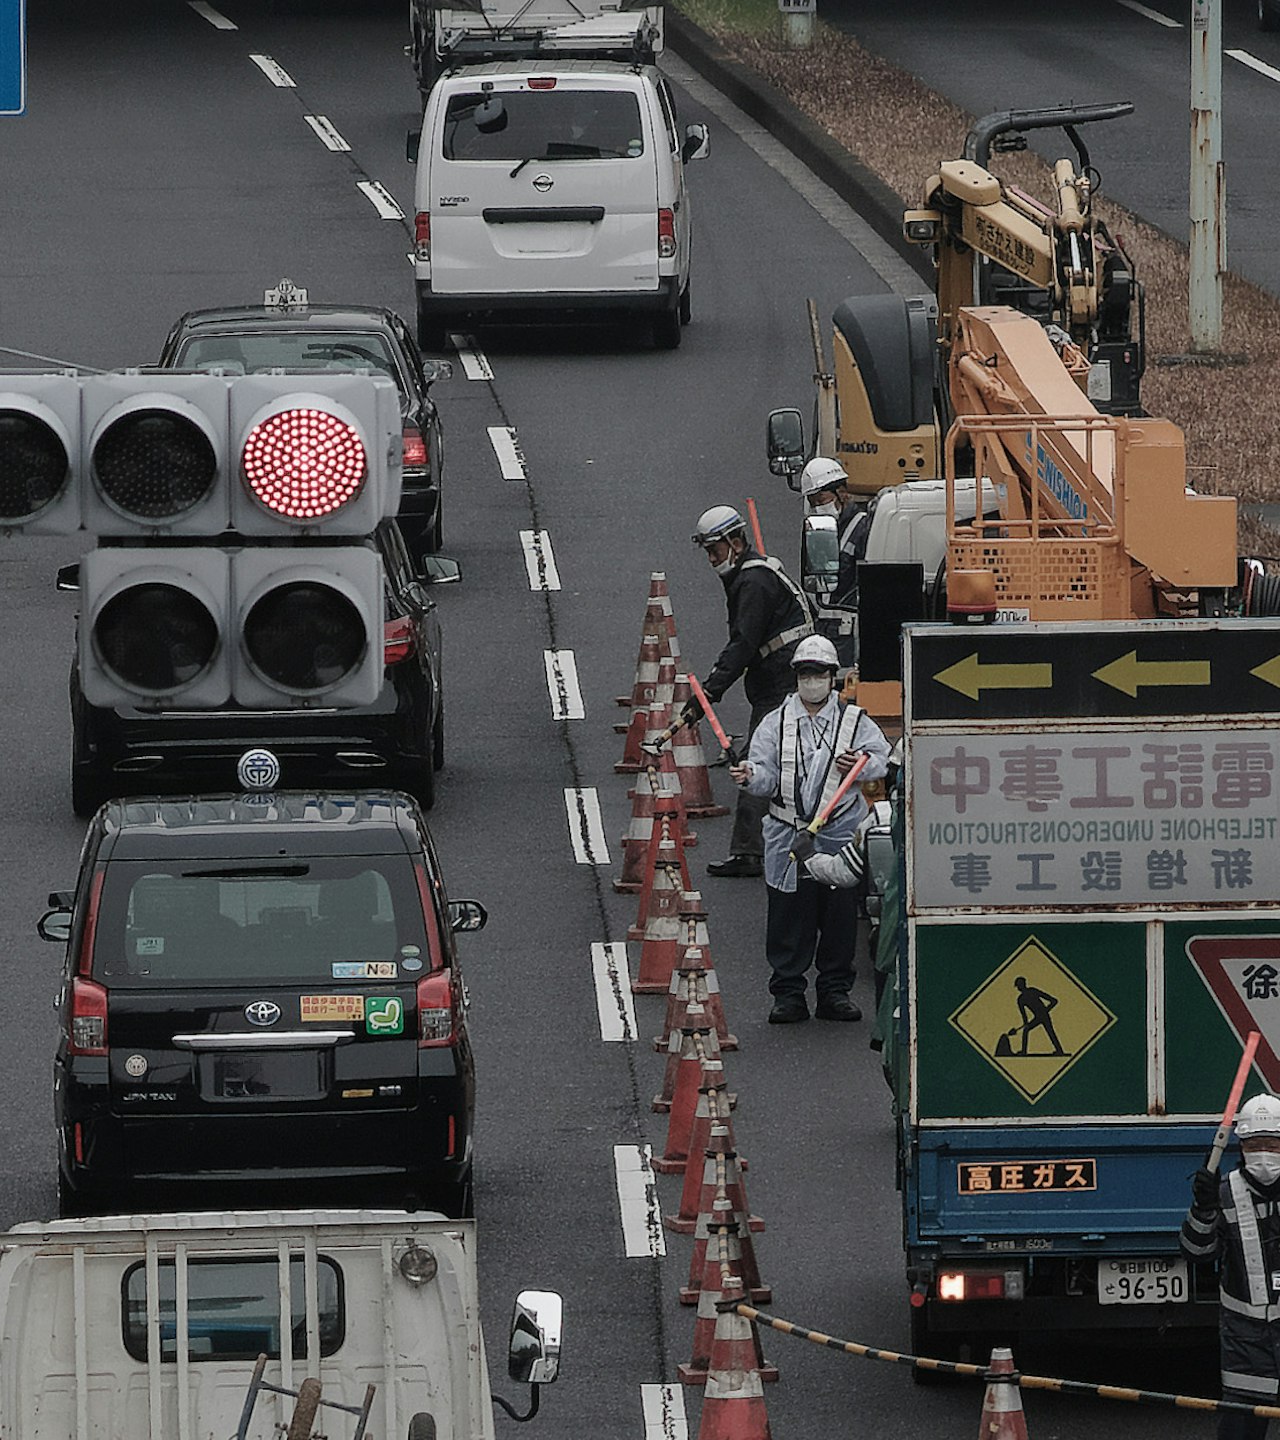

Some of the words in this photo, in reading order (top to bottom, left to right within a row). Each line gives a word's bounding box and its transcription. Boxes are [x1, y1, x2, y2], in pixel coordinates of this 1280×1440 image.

[966, 1163, 1089, 1191] 高圧ガス
[1117, 1275, 1183, 1300] 96-50
